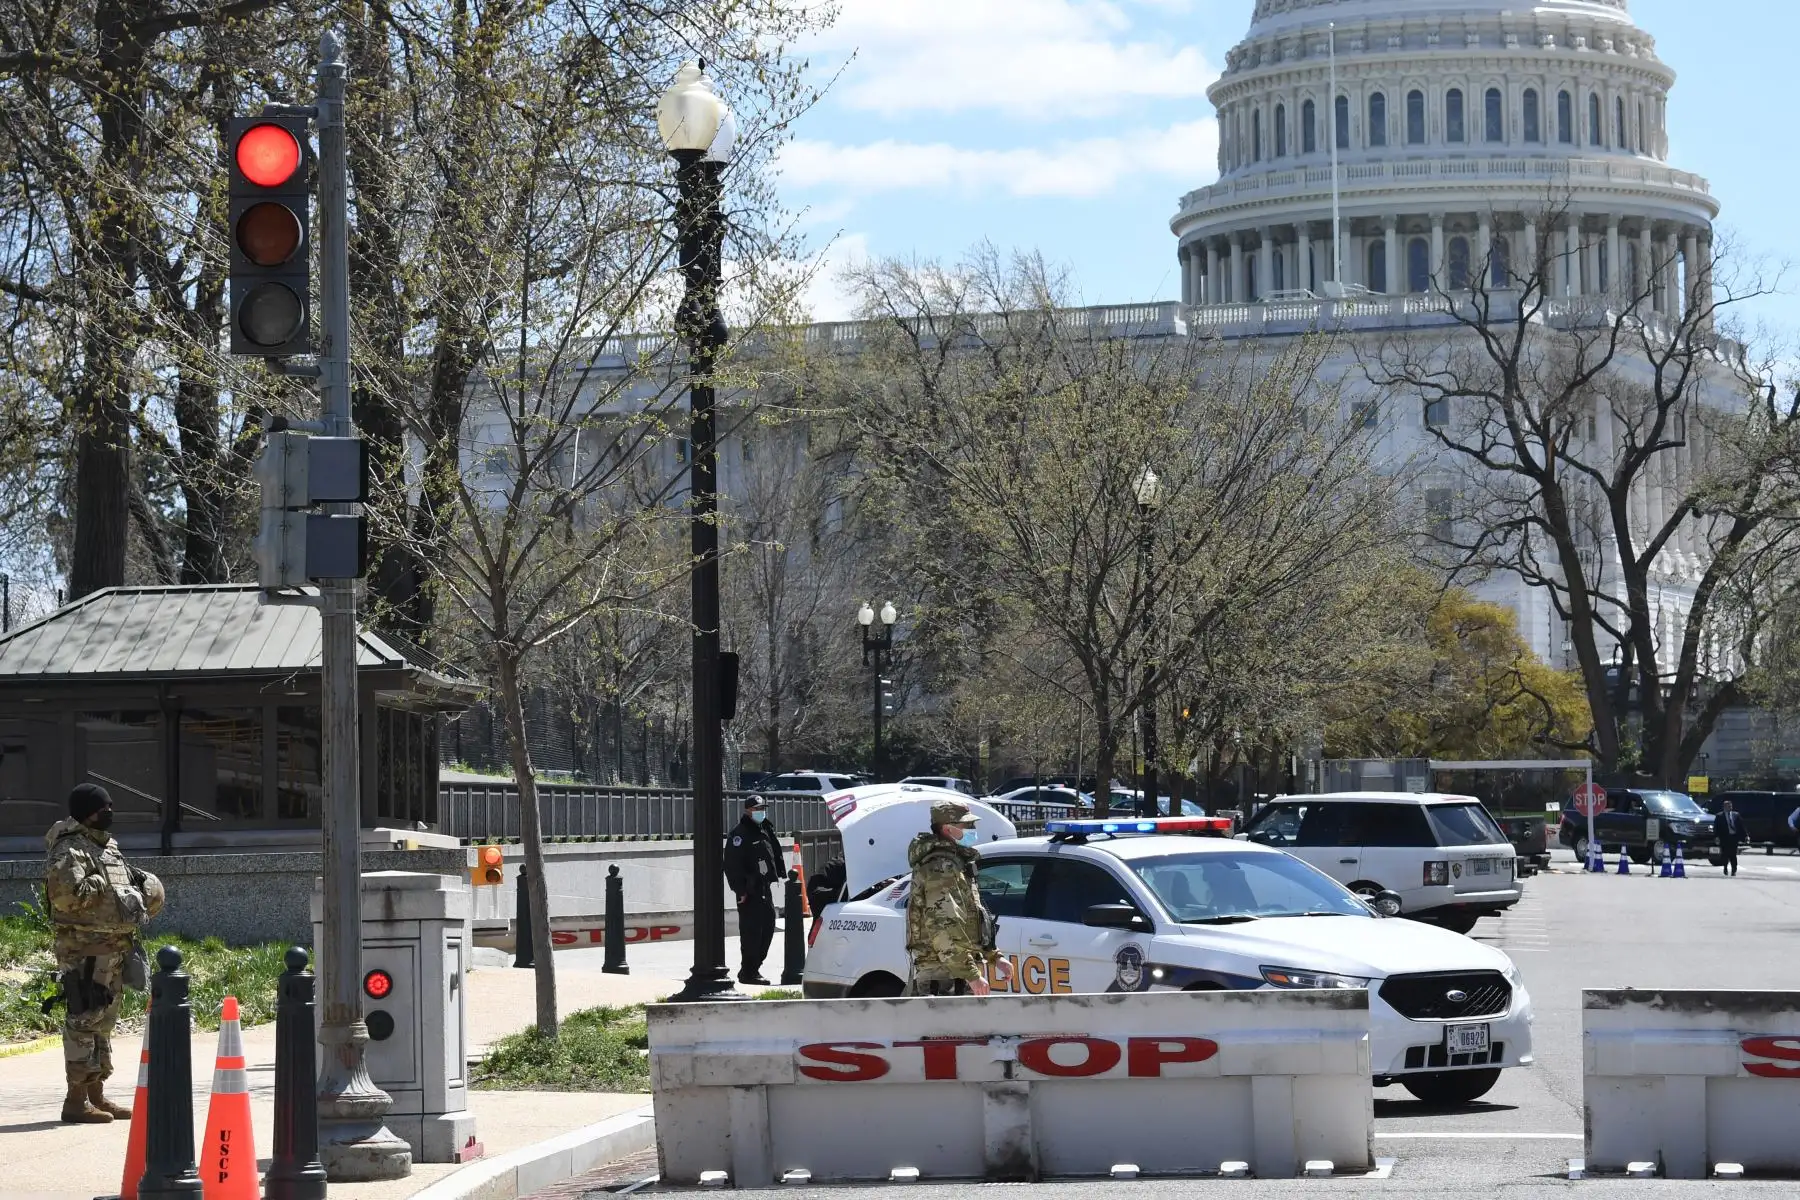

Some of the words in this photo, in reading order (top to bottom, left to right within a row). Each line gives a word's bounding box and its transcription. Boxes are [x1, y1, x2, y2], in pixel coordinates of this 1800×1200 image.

[828, 919, 877, 932] 202-228-2800
[976, 954, 1073, 994] LICE
[799, 1036, 1219, 1082] STOP
[219, 1129, 231, 1184] USCP
